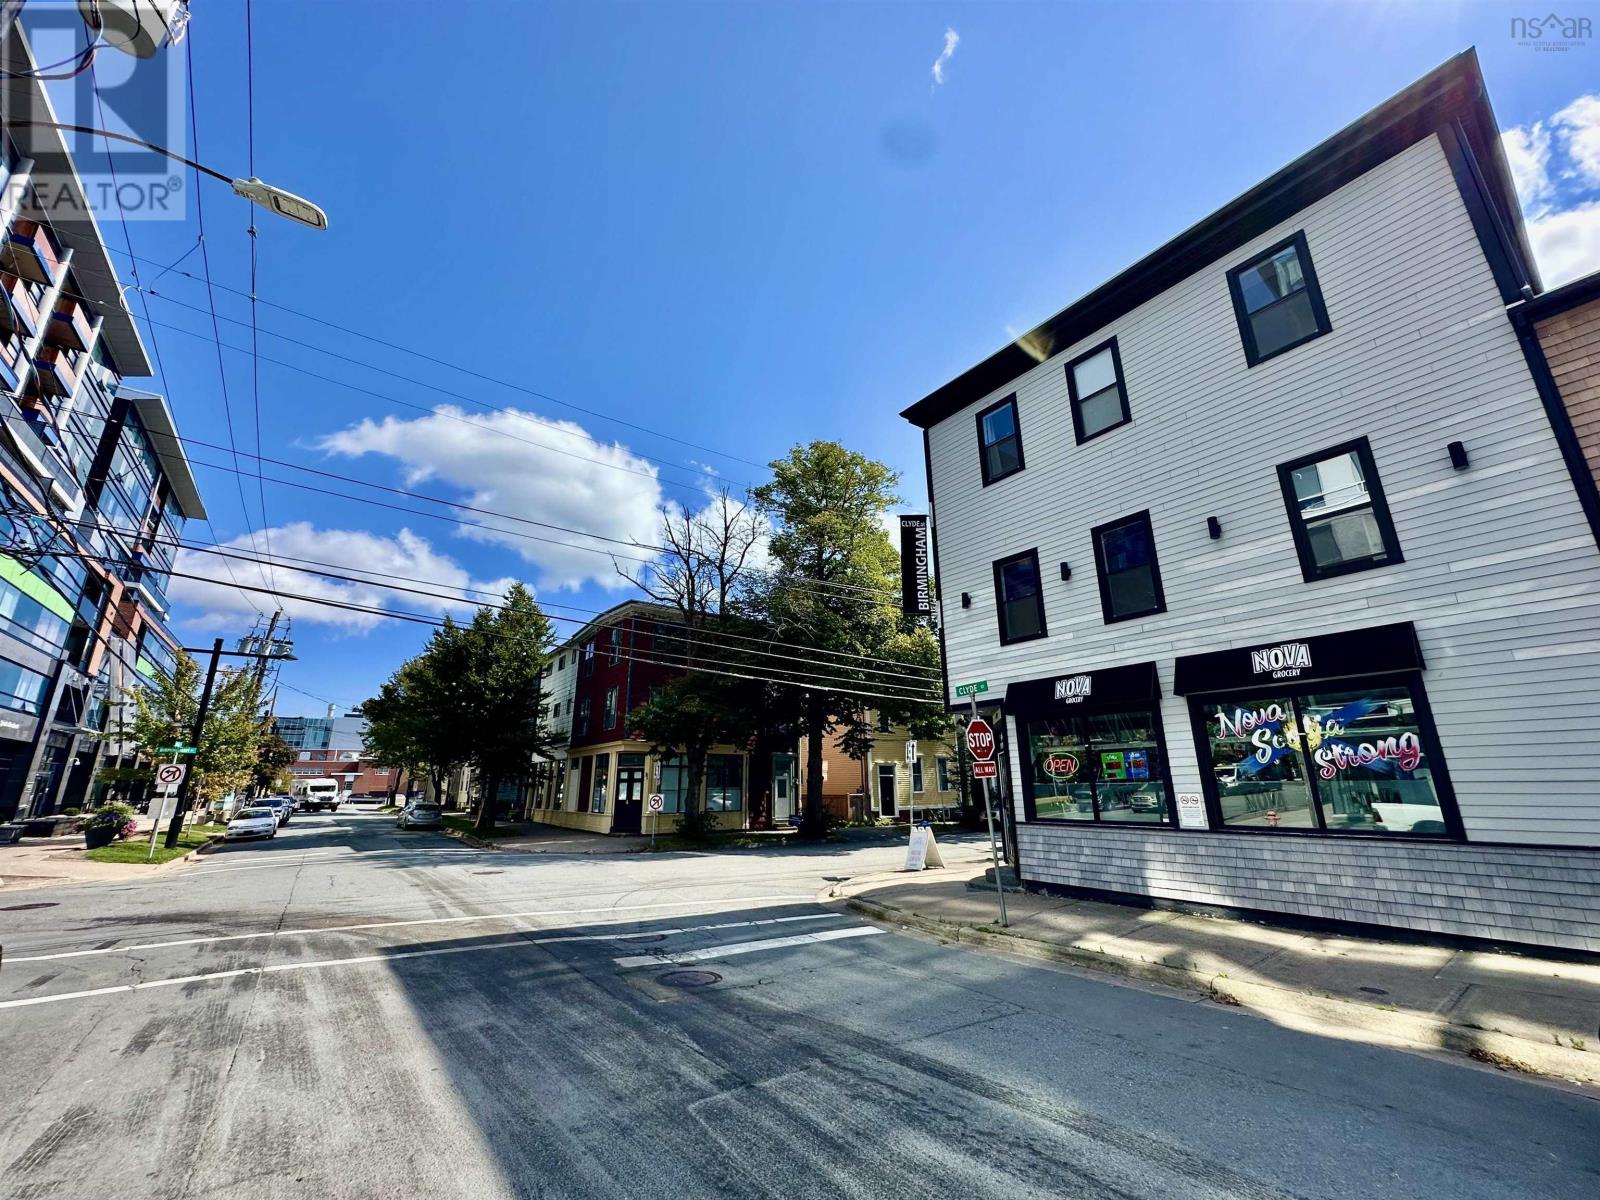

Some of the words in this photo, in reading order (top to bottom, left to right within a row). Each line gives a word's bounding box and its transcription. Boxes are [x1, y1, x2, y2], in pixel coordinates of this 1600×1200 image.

[901, 520, 920, 528] CLYDE
[915, 527, 930, 610] BIRMINGHAM
[1251, 642, 1312, 674] NOVA
[1272, 668, 1301, 679] GROCERY
[958, 684, 978, 695] CLYDE
[1055, 675, 1092, 700] NOVA
[1214, 703, 1287, 740] Nova
[968, 732, 992, 748] STOP
[1313, 731, 1421, 780] Strong
[975, 766, 985, 774] ALL
[984, 765, 995, 773] WAY
[1045, 758, 1076, 773] OPEN
